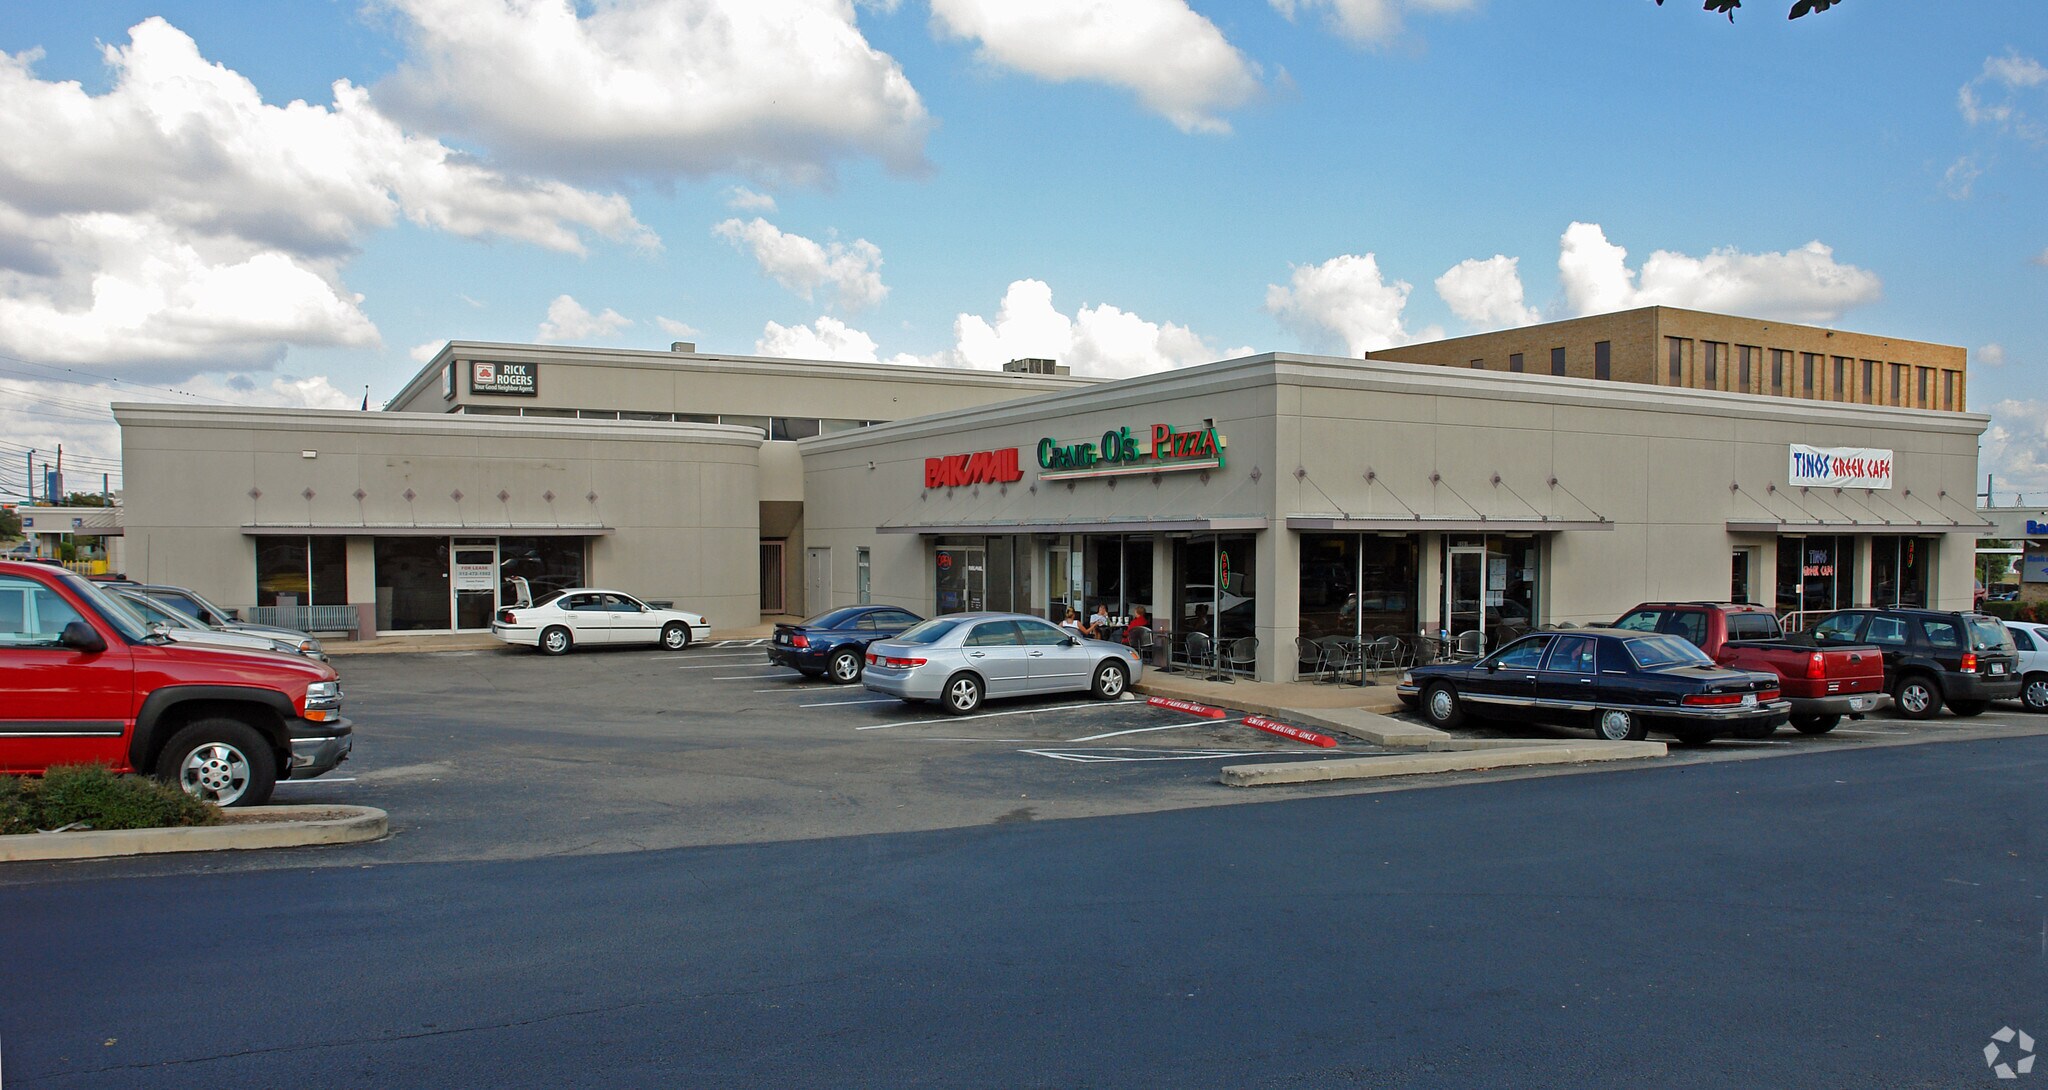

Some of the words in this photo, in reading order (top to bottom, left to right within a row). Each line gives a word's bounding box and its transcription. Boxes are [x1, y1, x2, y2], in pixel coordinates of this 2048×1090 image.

[503, 364, 526, 375] RICK
[497, 374, 533, 385] ROGERS
[498, 384, 518, 392] Neighbor
[1793, 452, 1830, 478] TINOS
[1832, 457, 1865, 478] GREEK
[1867, 458, 1890, 479] CAFE
[1808, 549, 1828, 564] TINOS
[1221, 553, 1229, 586] OPEN
[1803, 565, 1819, 576] GREEK
[1820, 565, 1834, 576] CAFE
[1166, 700, 1190, 709] PARKING
[1267, 722, 1298, 736] PARKING
[1298, 731, 1318, 741] ONLY
